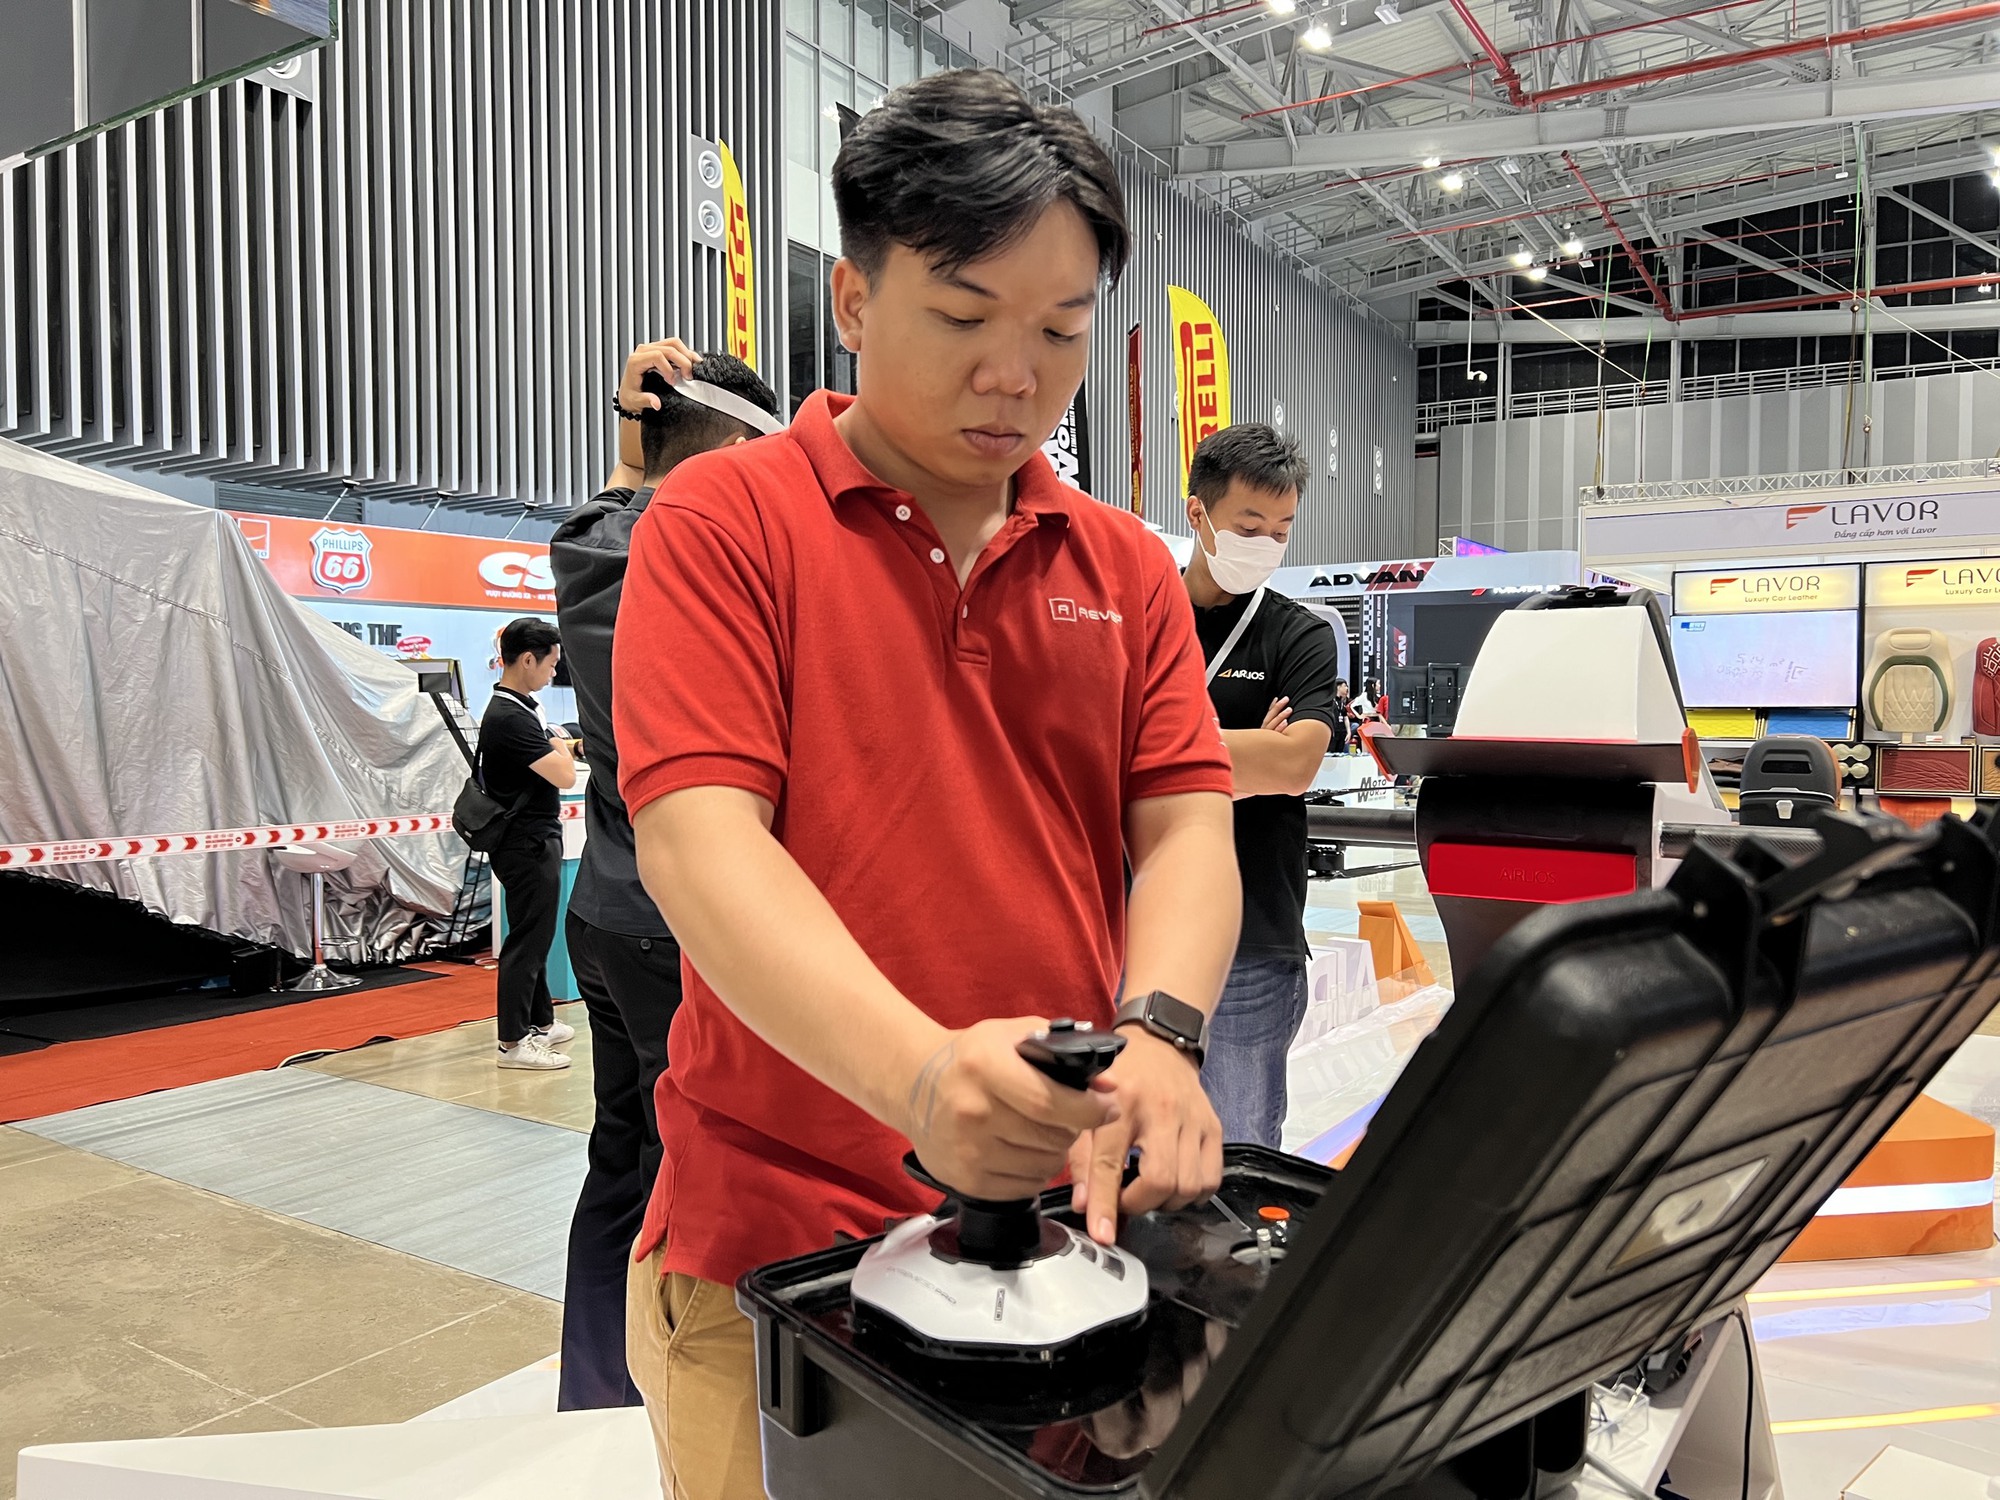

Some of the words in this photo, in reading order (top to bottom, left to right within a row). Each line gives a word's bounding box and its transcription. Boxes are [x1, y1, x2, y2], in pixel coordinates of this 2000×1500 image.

[1832, 500, 1938, 525] LAVOR
[1911, 526, 1937, 535] Lavor
[322, 538, 363, 551] PHILLIPS
[324, 555, 360, 579] 66
[1309, 569, 1425, 588] ADVAN
[1743, 575, 1820, 593] LAVOR
[1788, 594, 1818, 602] Leather
[1945, 588, 1973, 596] Luxury
[367, 623, 403, 646] THE
